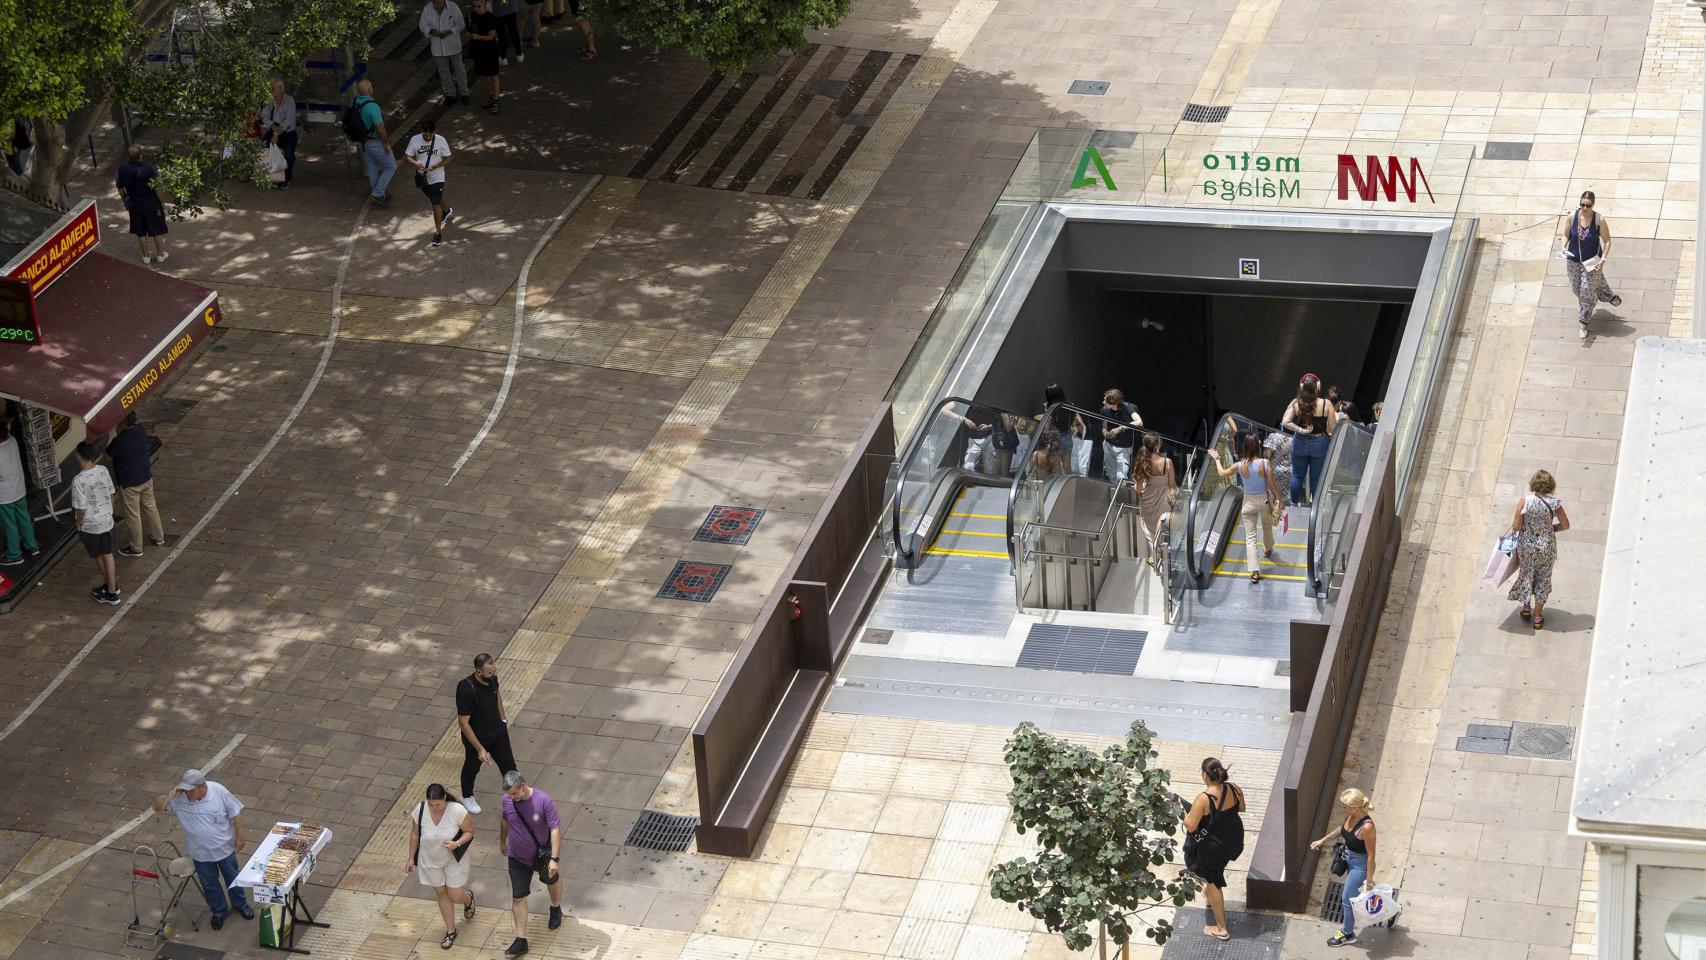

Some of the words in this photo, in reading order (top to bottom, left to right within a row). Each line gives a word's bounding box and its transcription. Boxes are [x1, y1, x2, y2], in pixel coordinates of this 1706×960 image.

[18, 255, 48, 280] ANCO
[50, 216, 94, 264] ALAMEDA
[120, 368, 158, 409] ESTANCO
[158, 333, 193, 374] ALAMEDA
